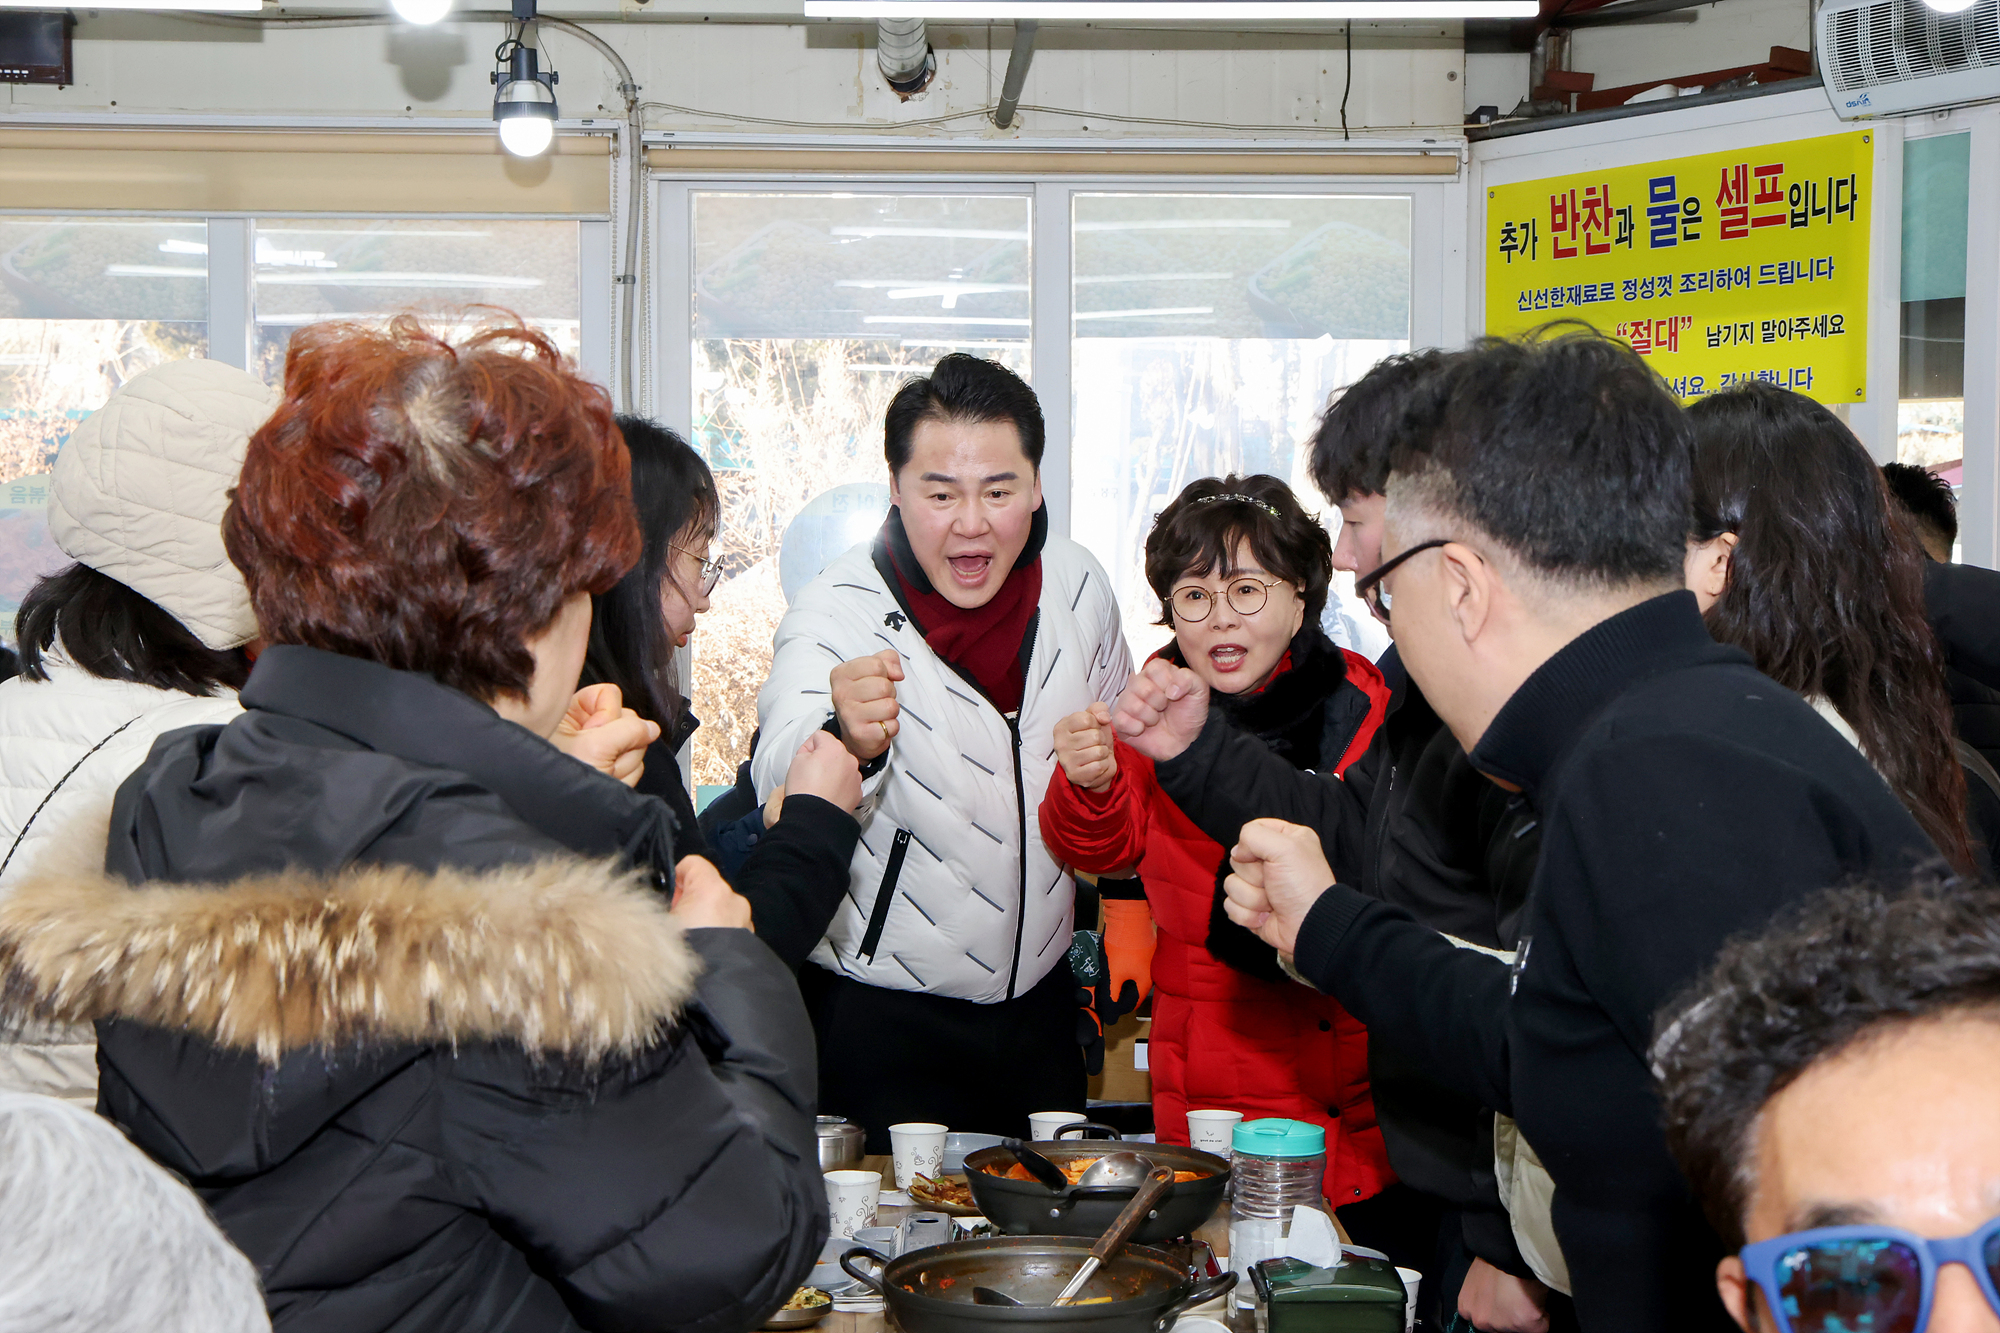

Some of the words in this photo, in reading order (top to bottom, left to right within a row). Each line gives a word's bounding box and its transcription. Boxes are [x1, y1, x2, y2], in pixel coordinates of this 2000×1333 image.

[1499, 218, 1539, 264] 추가
[1550, 184, 1635, 260] 반찬과
[1646, 175, 1702, 249] 물은
[1715, 163, 1858, 241] 셀프입니다
[1517, 282, 1616, 312] 신선한재료로
[1621, 274, 1673, 301] 정성껏
[1679, 265, 1751, 295] 조리하여
[1757, 256, 1835, 285] 드립니다
[1706, 321, 1754, 348] 남기지
[1761, 313, 1845, 344] 말아주세요
